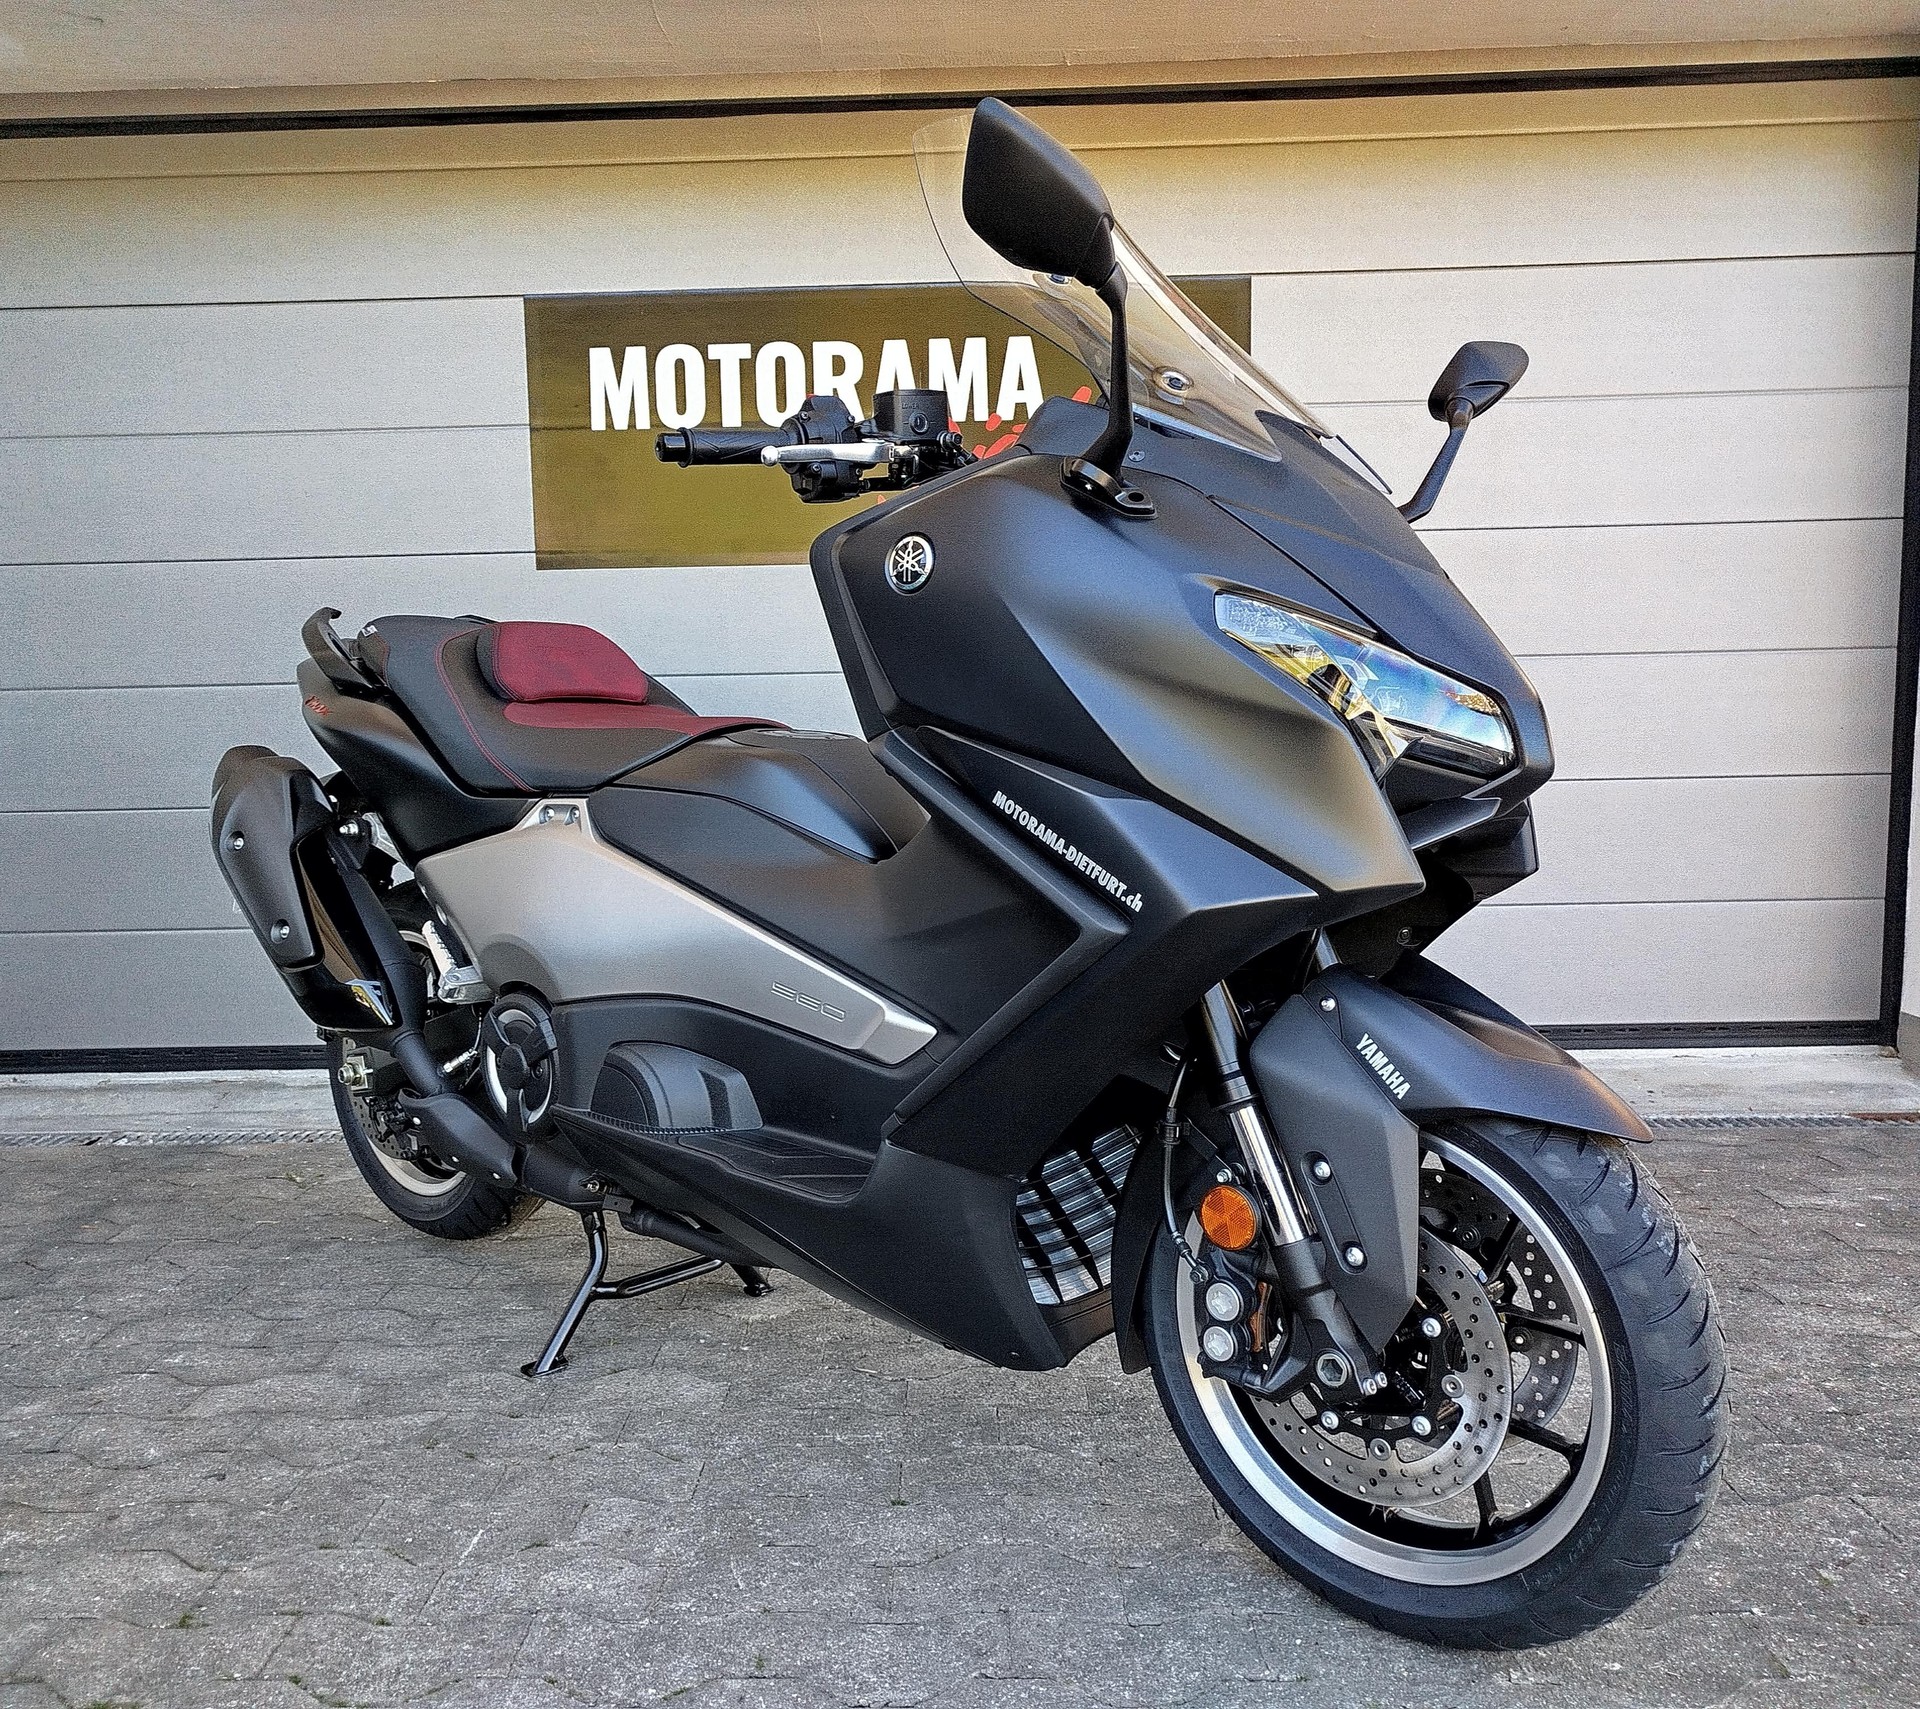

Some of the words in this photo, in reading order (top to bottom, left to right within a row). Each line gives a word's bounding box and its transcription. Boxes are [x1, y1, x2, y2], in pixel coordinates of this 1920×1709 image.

[589, 335, 1044, 431] MOTORAMA
[992, 790, 1143, 913] MOTORAMA-DIETFURT.ch
[770, 981, 847, 1023] 560
[1356, 1032, 1412, 1100] YAMAHA
